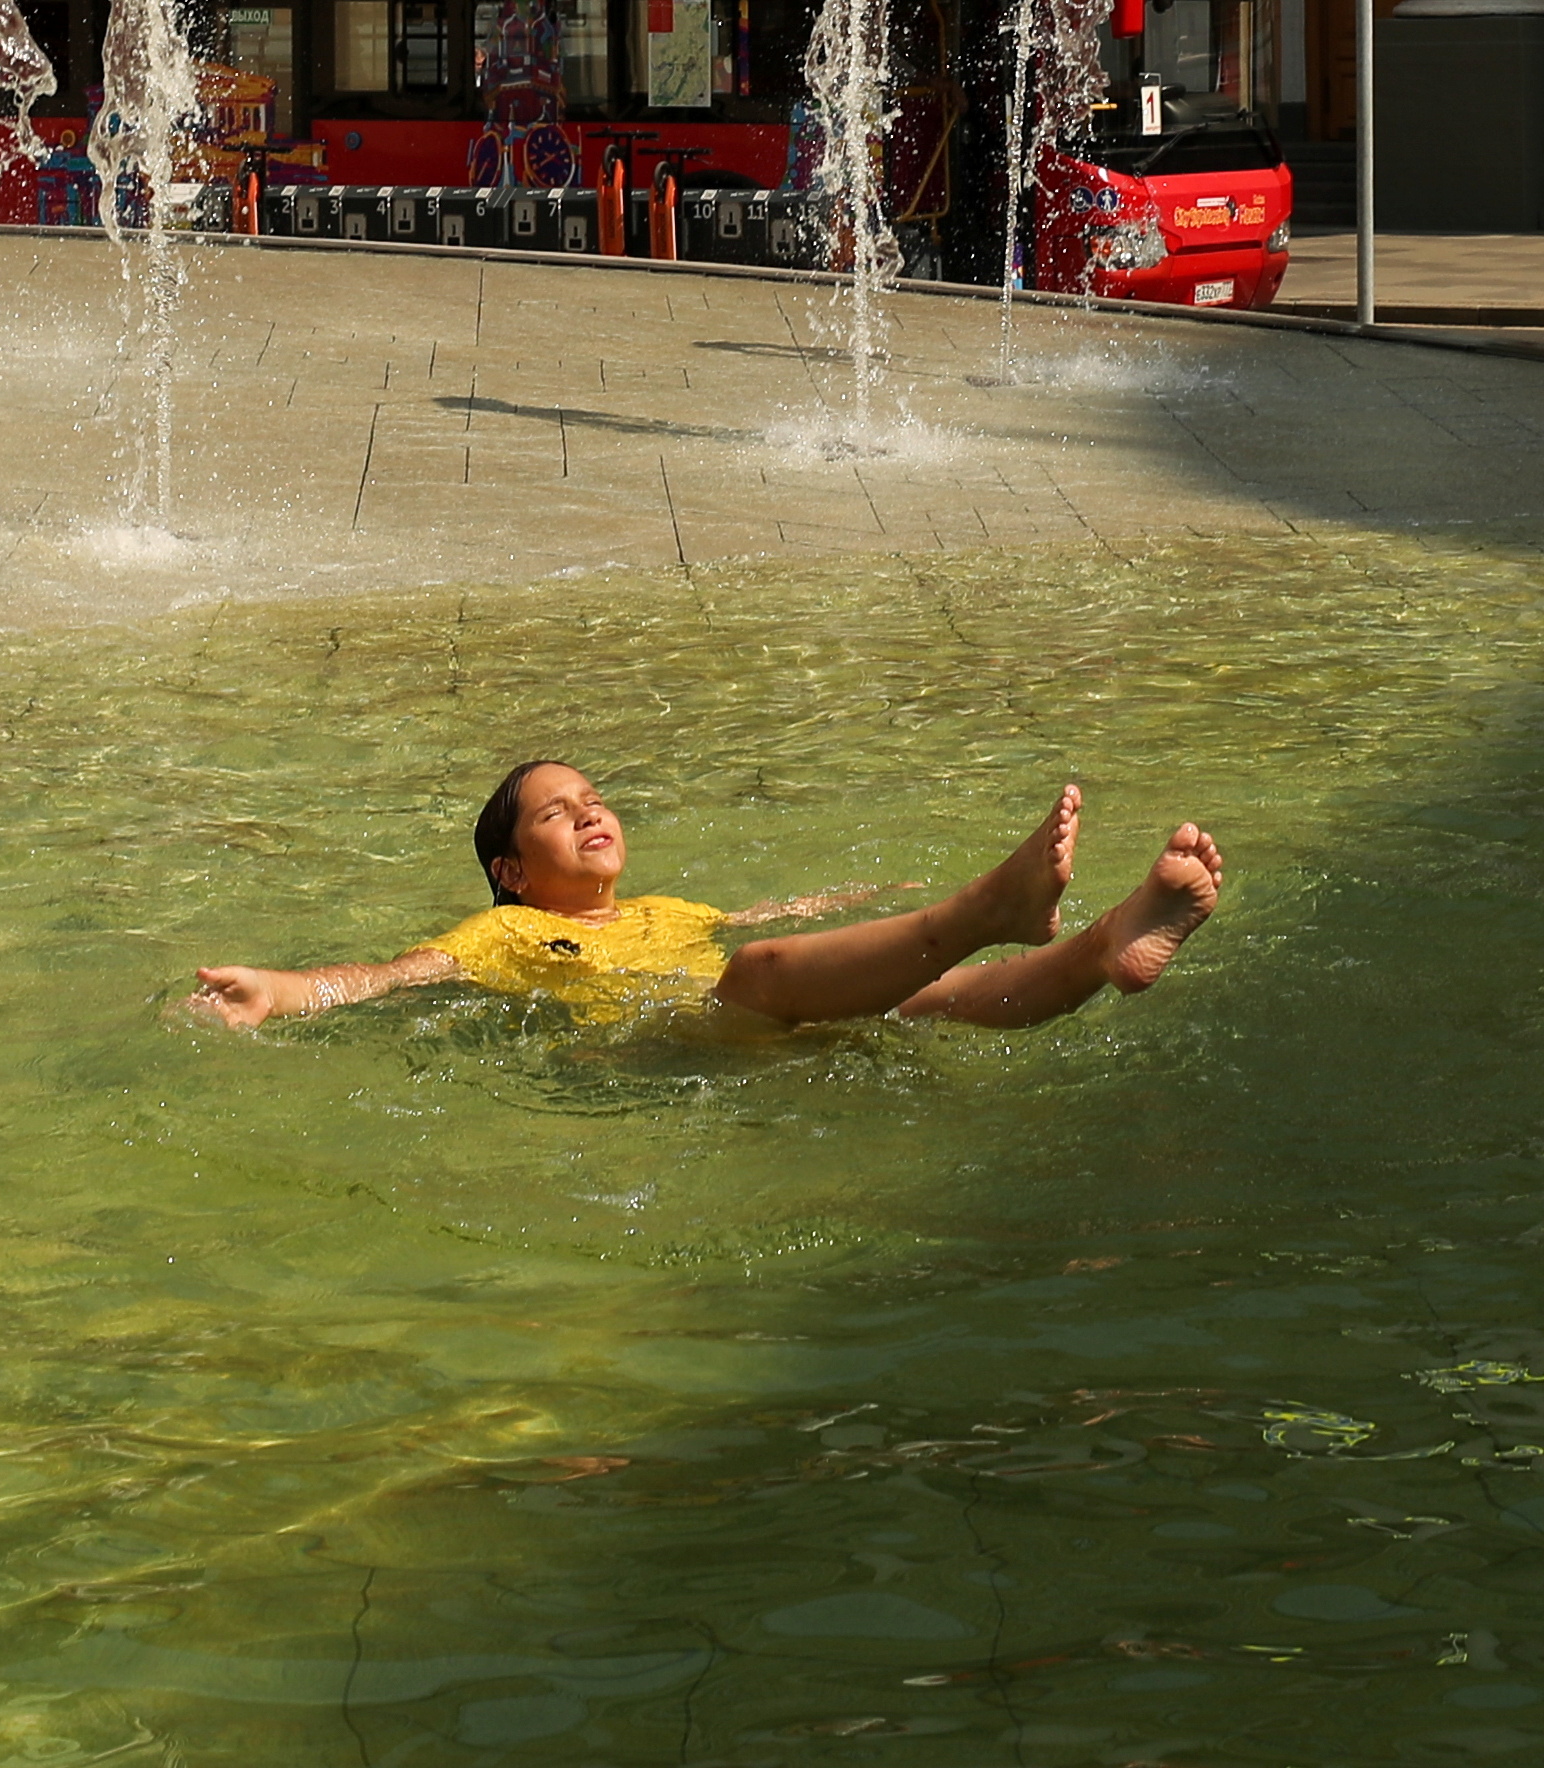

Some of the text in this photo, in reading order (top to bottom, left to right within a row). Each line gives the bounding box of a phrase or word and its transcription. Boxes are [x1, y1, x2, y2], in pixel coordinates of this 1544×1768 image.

[231, 10, 269, 23] ВЫХОД
[1146, 91, 1154, 124] 1
[281, 199, 291, 214] 2
[330, 199, 339, 215] 3
[376, 200, 387, 216] 4
[427, 200, 436, 216] 5
[476, 201, 485, 217] 6
[548, 202, 557, 218] 7
[693, 204, 712, 219] 10
[747, 205, 765, 220] 11
